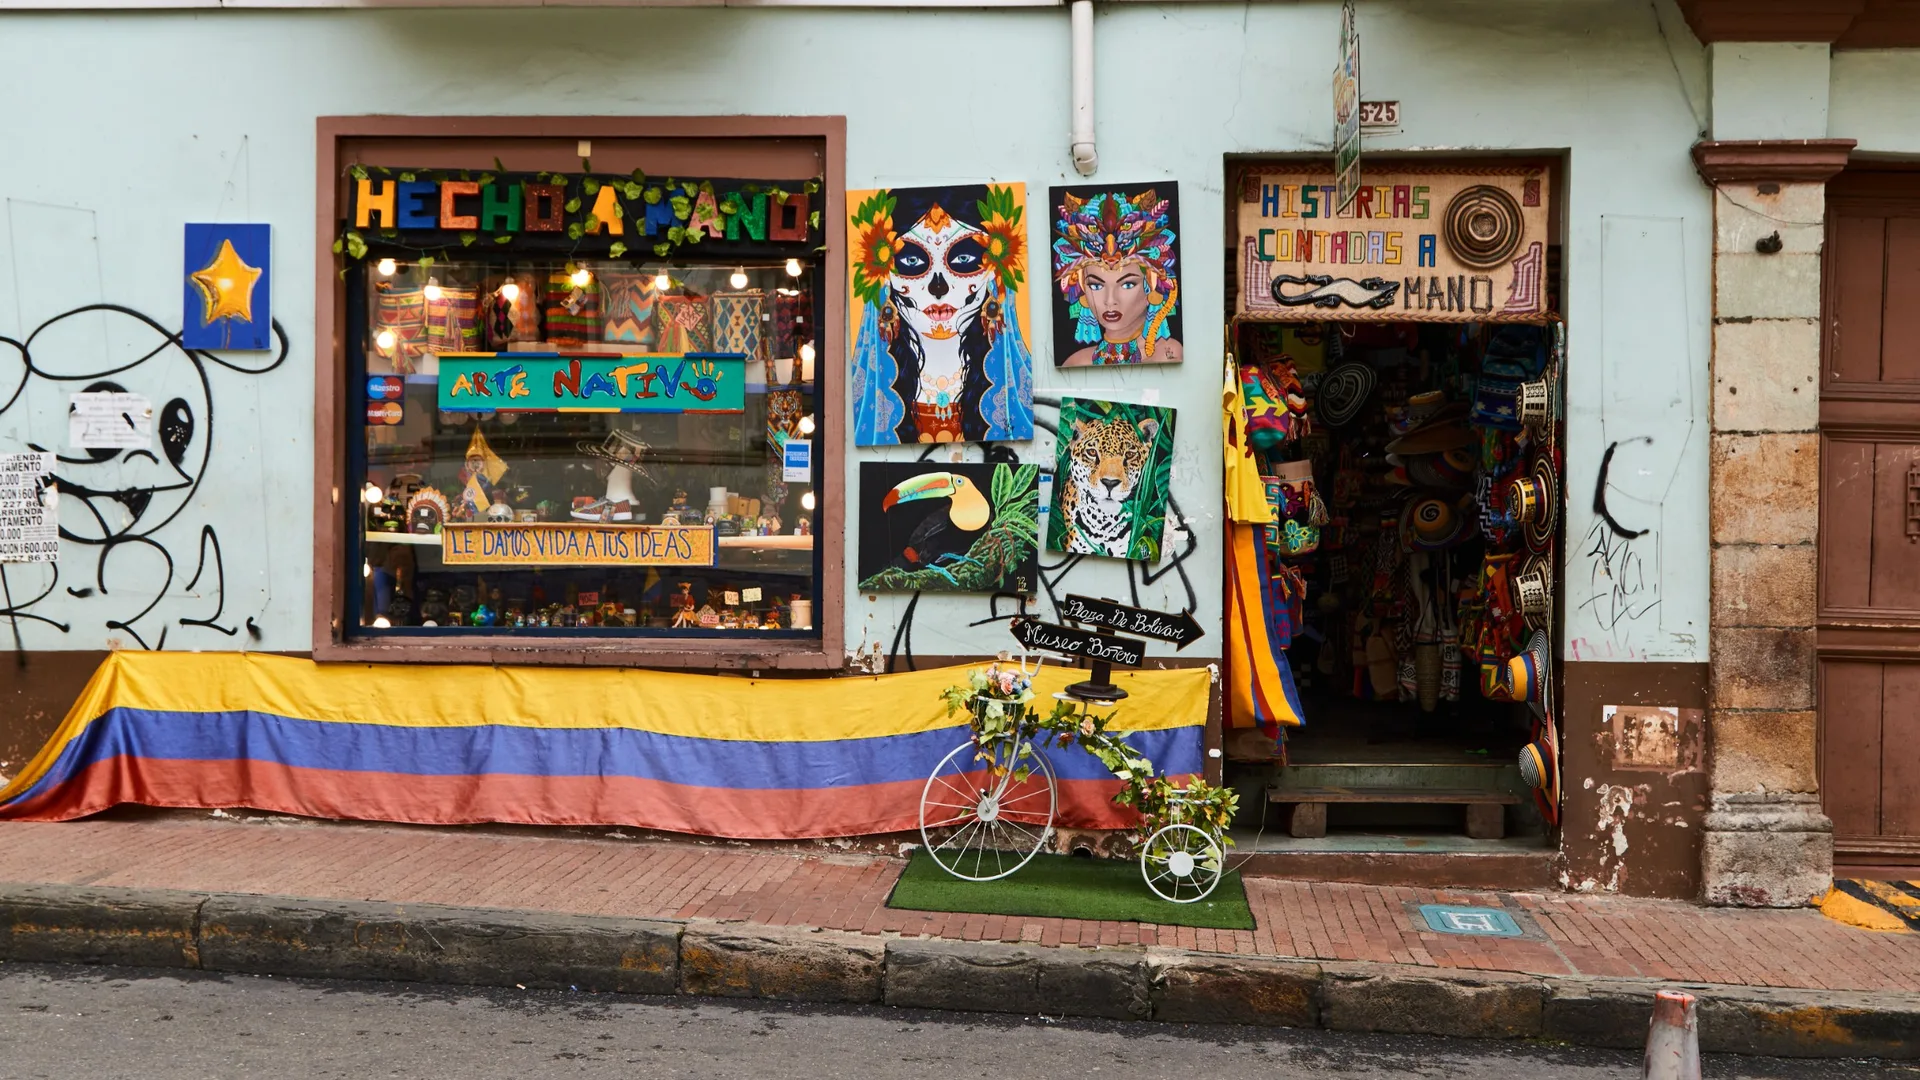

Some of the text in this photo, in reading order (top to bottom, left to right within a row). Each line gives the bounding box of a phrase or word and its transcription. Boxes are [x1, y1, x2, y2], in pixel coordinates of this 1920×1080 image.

[355, 179, 809, 241] HECHO A MANO
[1262, 184, 1430, 219] HISTRIAS
[1258, 228, 1437, 267] CONTADAS A
[1403, 274, 1494, 314] MANO
[369, 384, 401, 393] Maestro
[450, 358, 723, 401] ARTE NATIVO
[0, 508, 44, 516] RRIENDA
[2, 500, 22, 508] 227
[44, 553, 58, 561] 33
[450, 528, 692, 560] LE DAMOS VIDA A TUS IDEAS
[1064, 599, 1105, 623] Plaza
[1108, 608, 1128, 628] De
[1024, 622, 1083, 651] Museo
